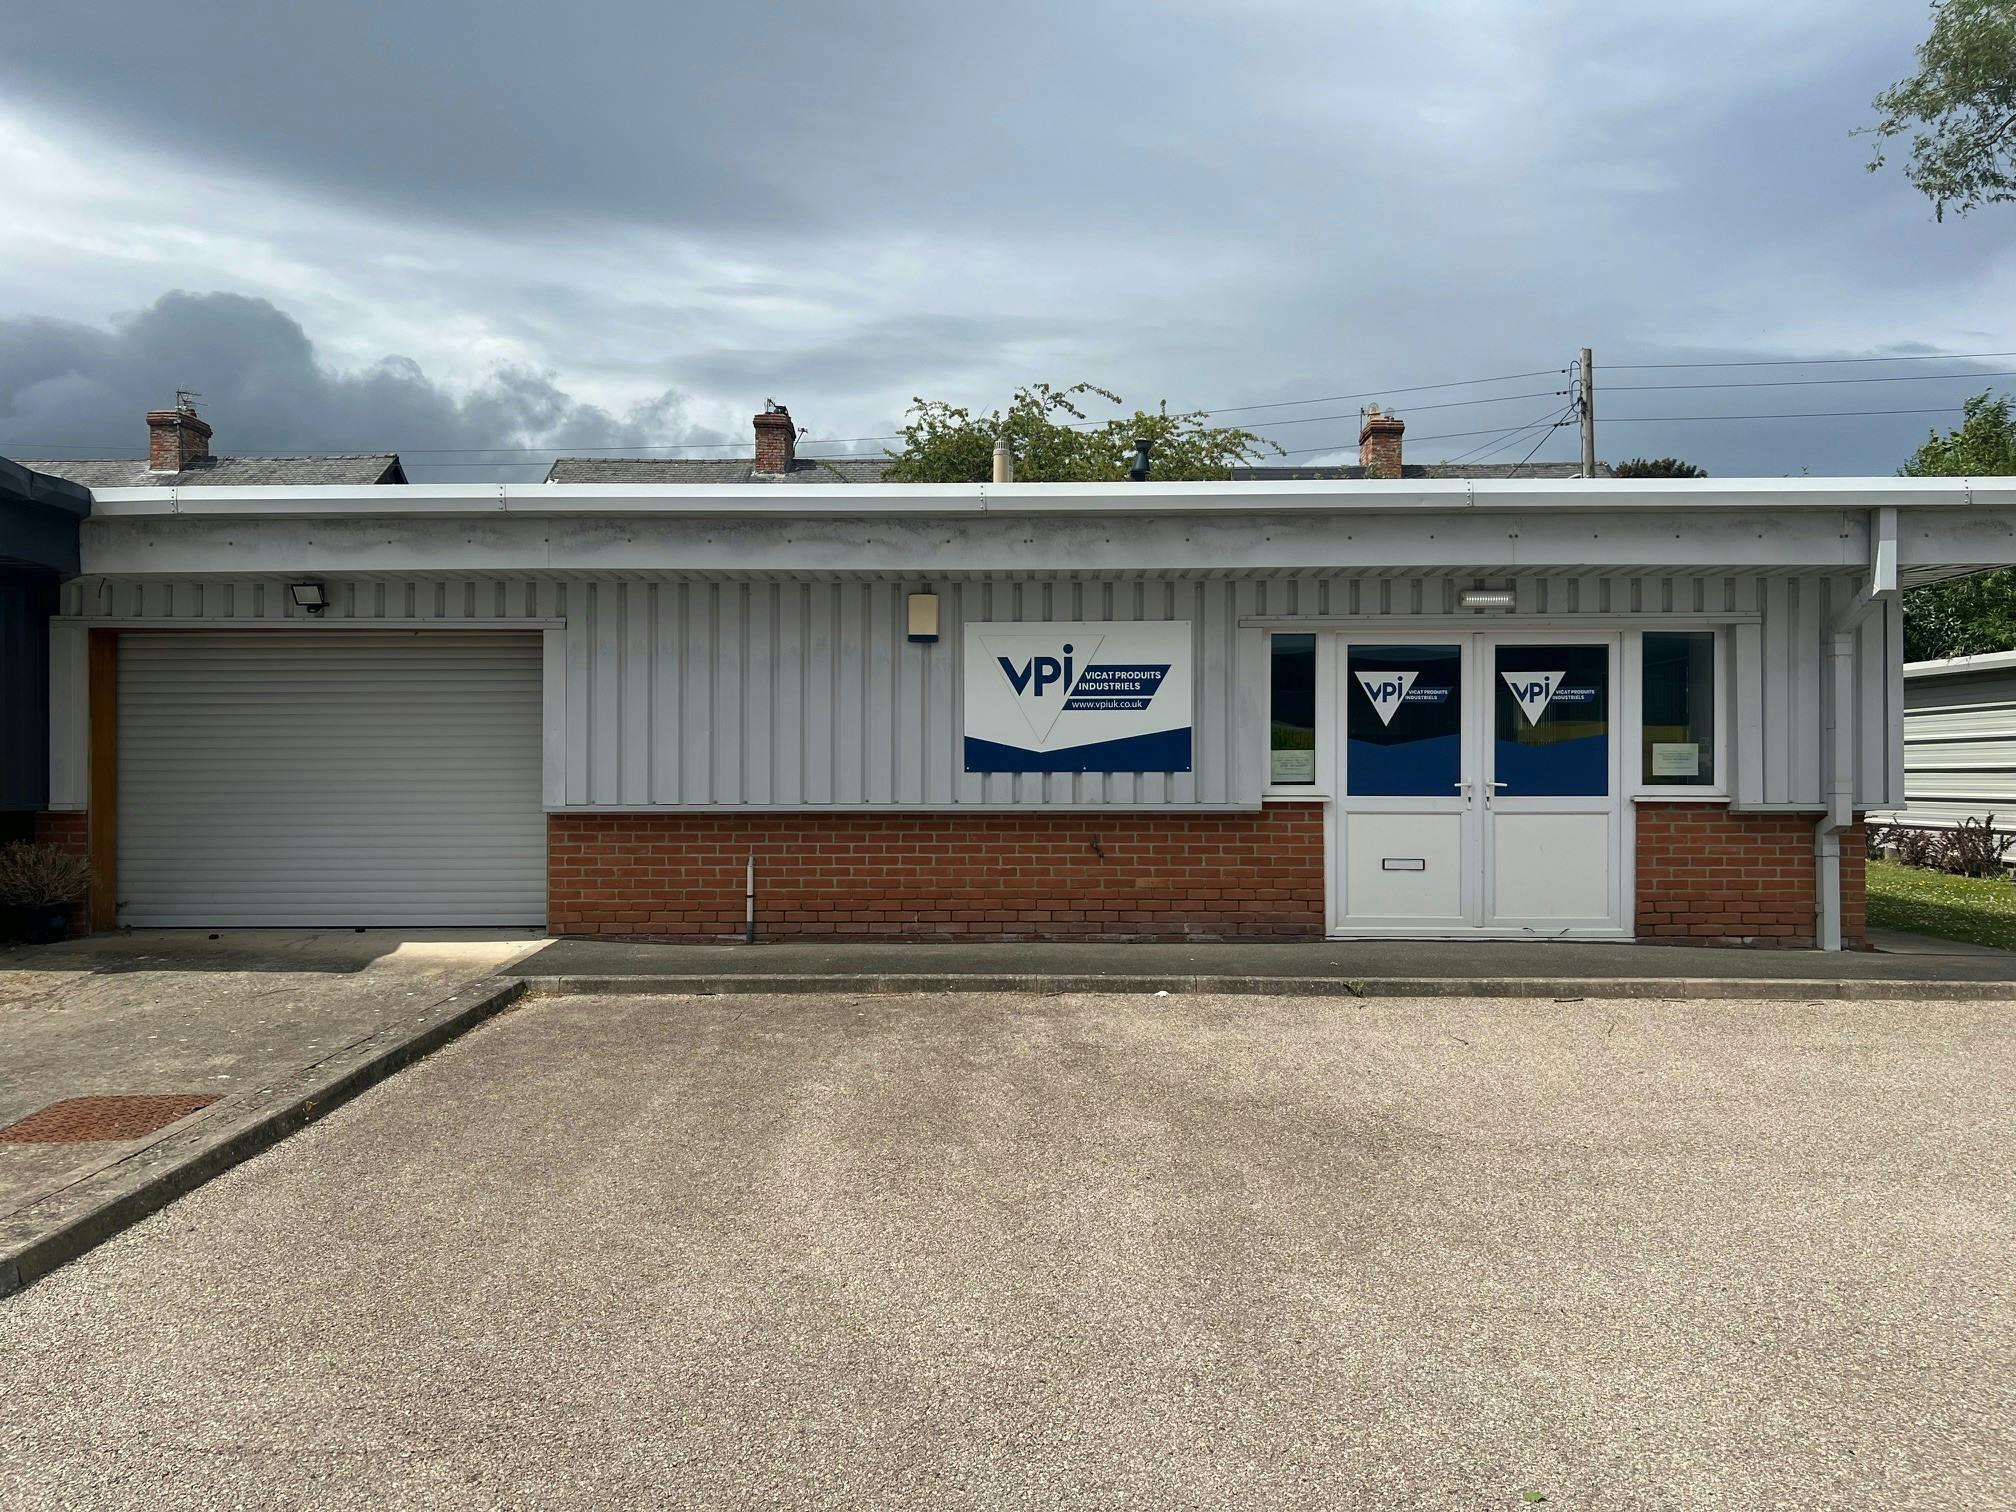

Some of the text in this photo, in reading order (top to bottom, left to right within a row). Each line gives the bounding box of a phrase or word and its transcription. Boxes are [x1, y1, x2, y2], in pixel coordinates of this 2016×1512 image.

[1085, 671, 1161, 680] VICAT PRODUITS
[1078, 682, 1141, 690] INDUSTRIELS
[1071, 700, 1143, 709] www.vpiuk.co.uk
